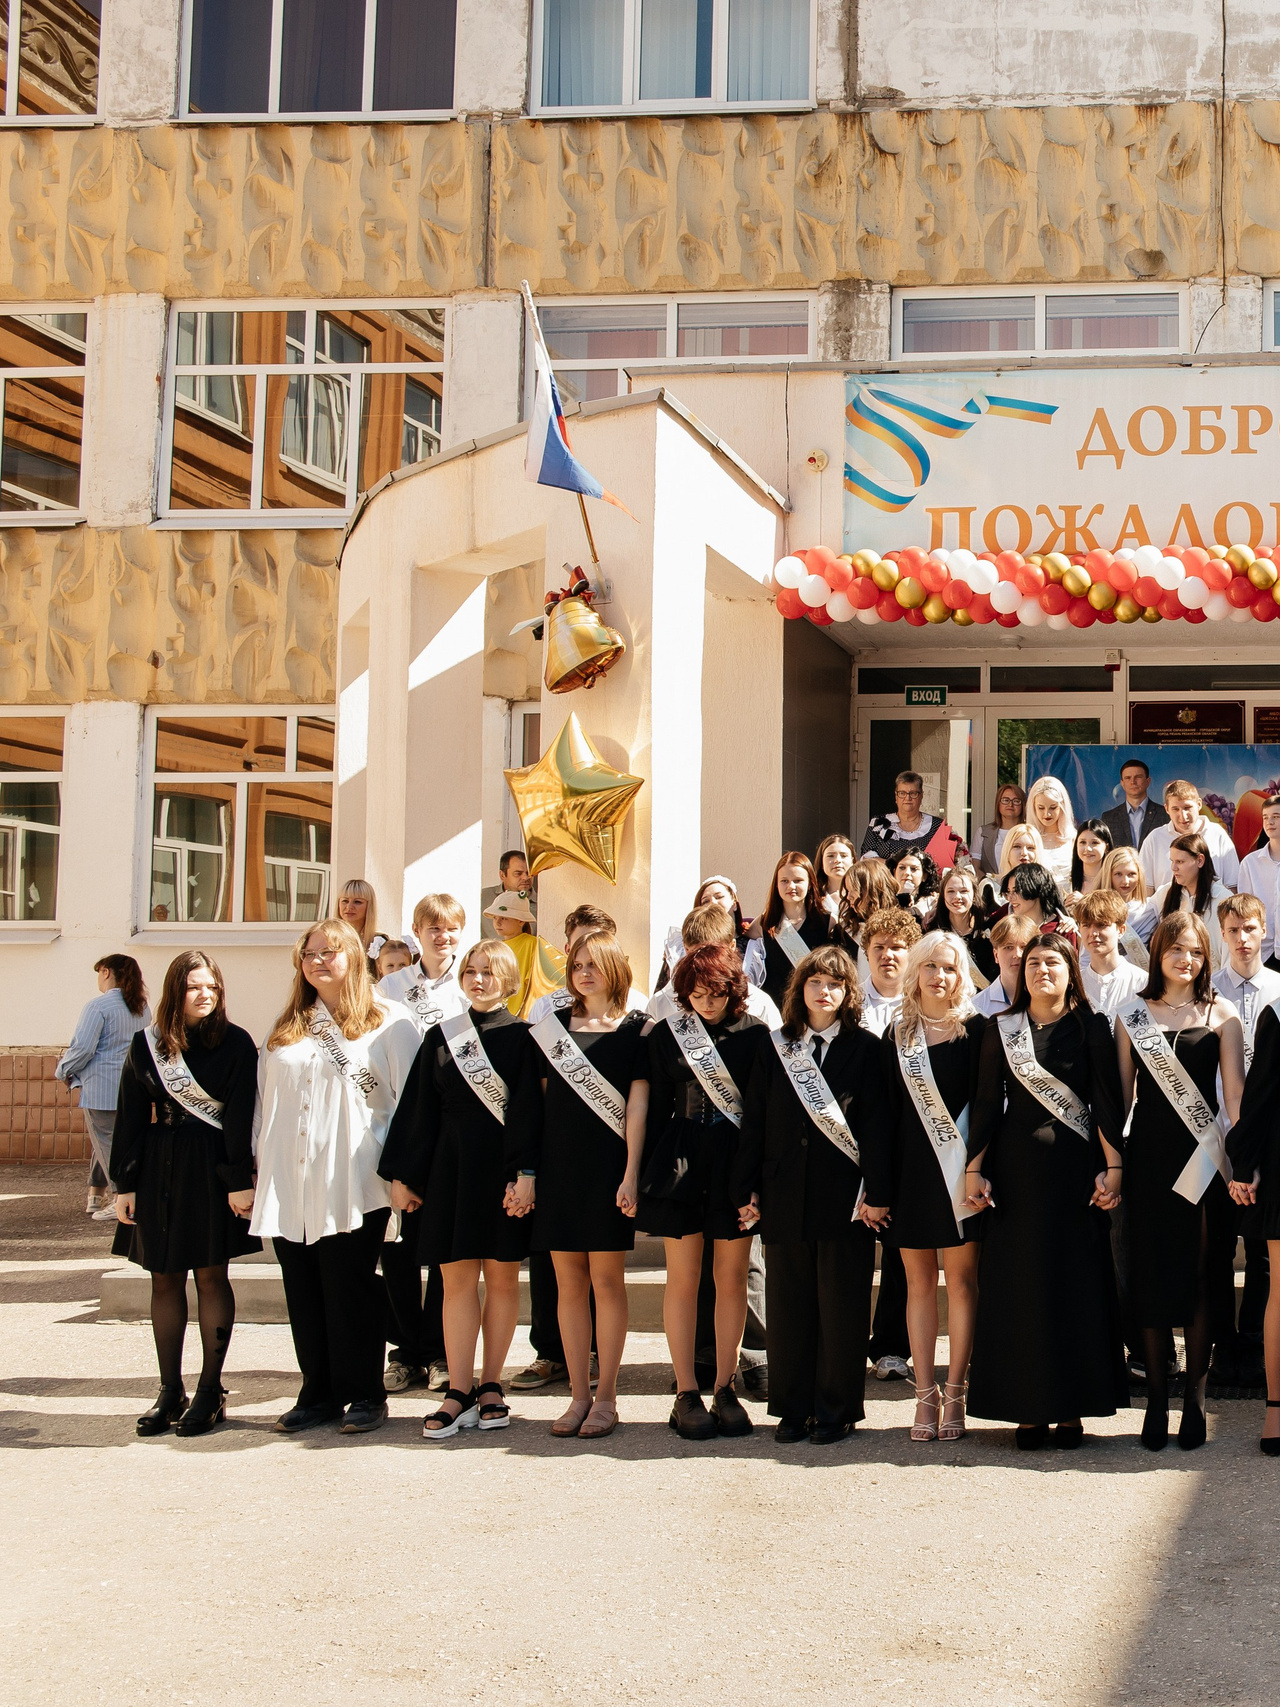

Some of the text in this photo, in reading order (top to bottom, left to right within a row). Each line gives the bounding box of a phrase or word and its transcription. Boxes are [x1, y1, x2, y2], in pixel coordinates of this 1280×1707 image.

[911, 690, 941, 704] ВХОД
[308, 1012, 379, 1094] Выпускник 2025
[682, 1036, 737, 1113] Выпускник
[901, 1036, 958, 1143] Выпускник 2025
[1010, 1051, 1074, 1121] Выпускник
[1132, 1026, 1190, 1106] Выпускник
[1186, 1100, 1214, 1129] 2025
